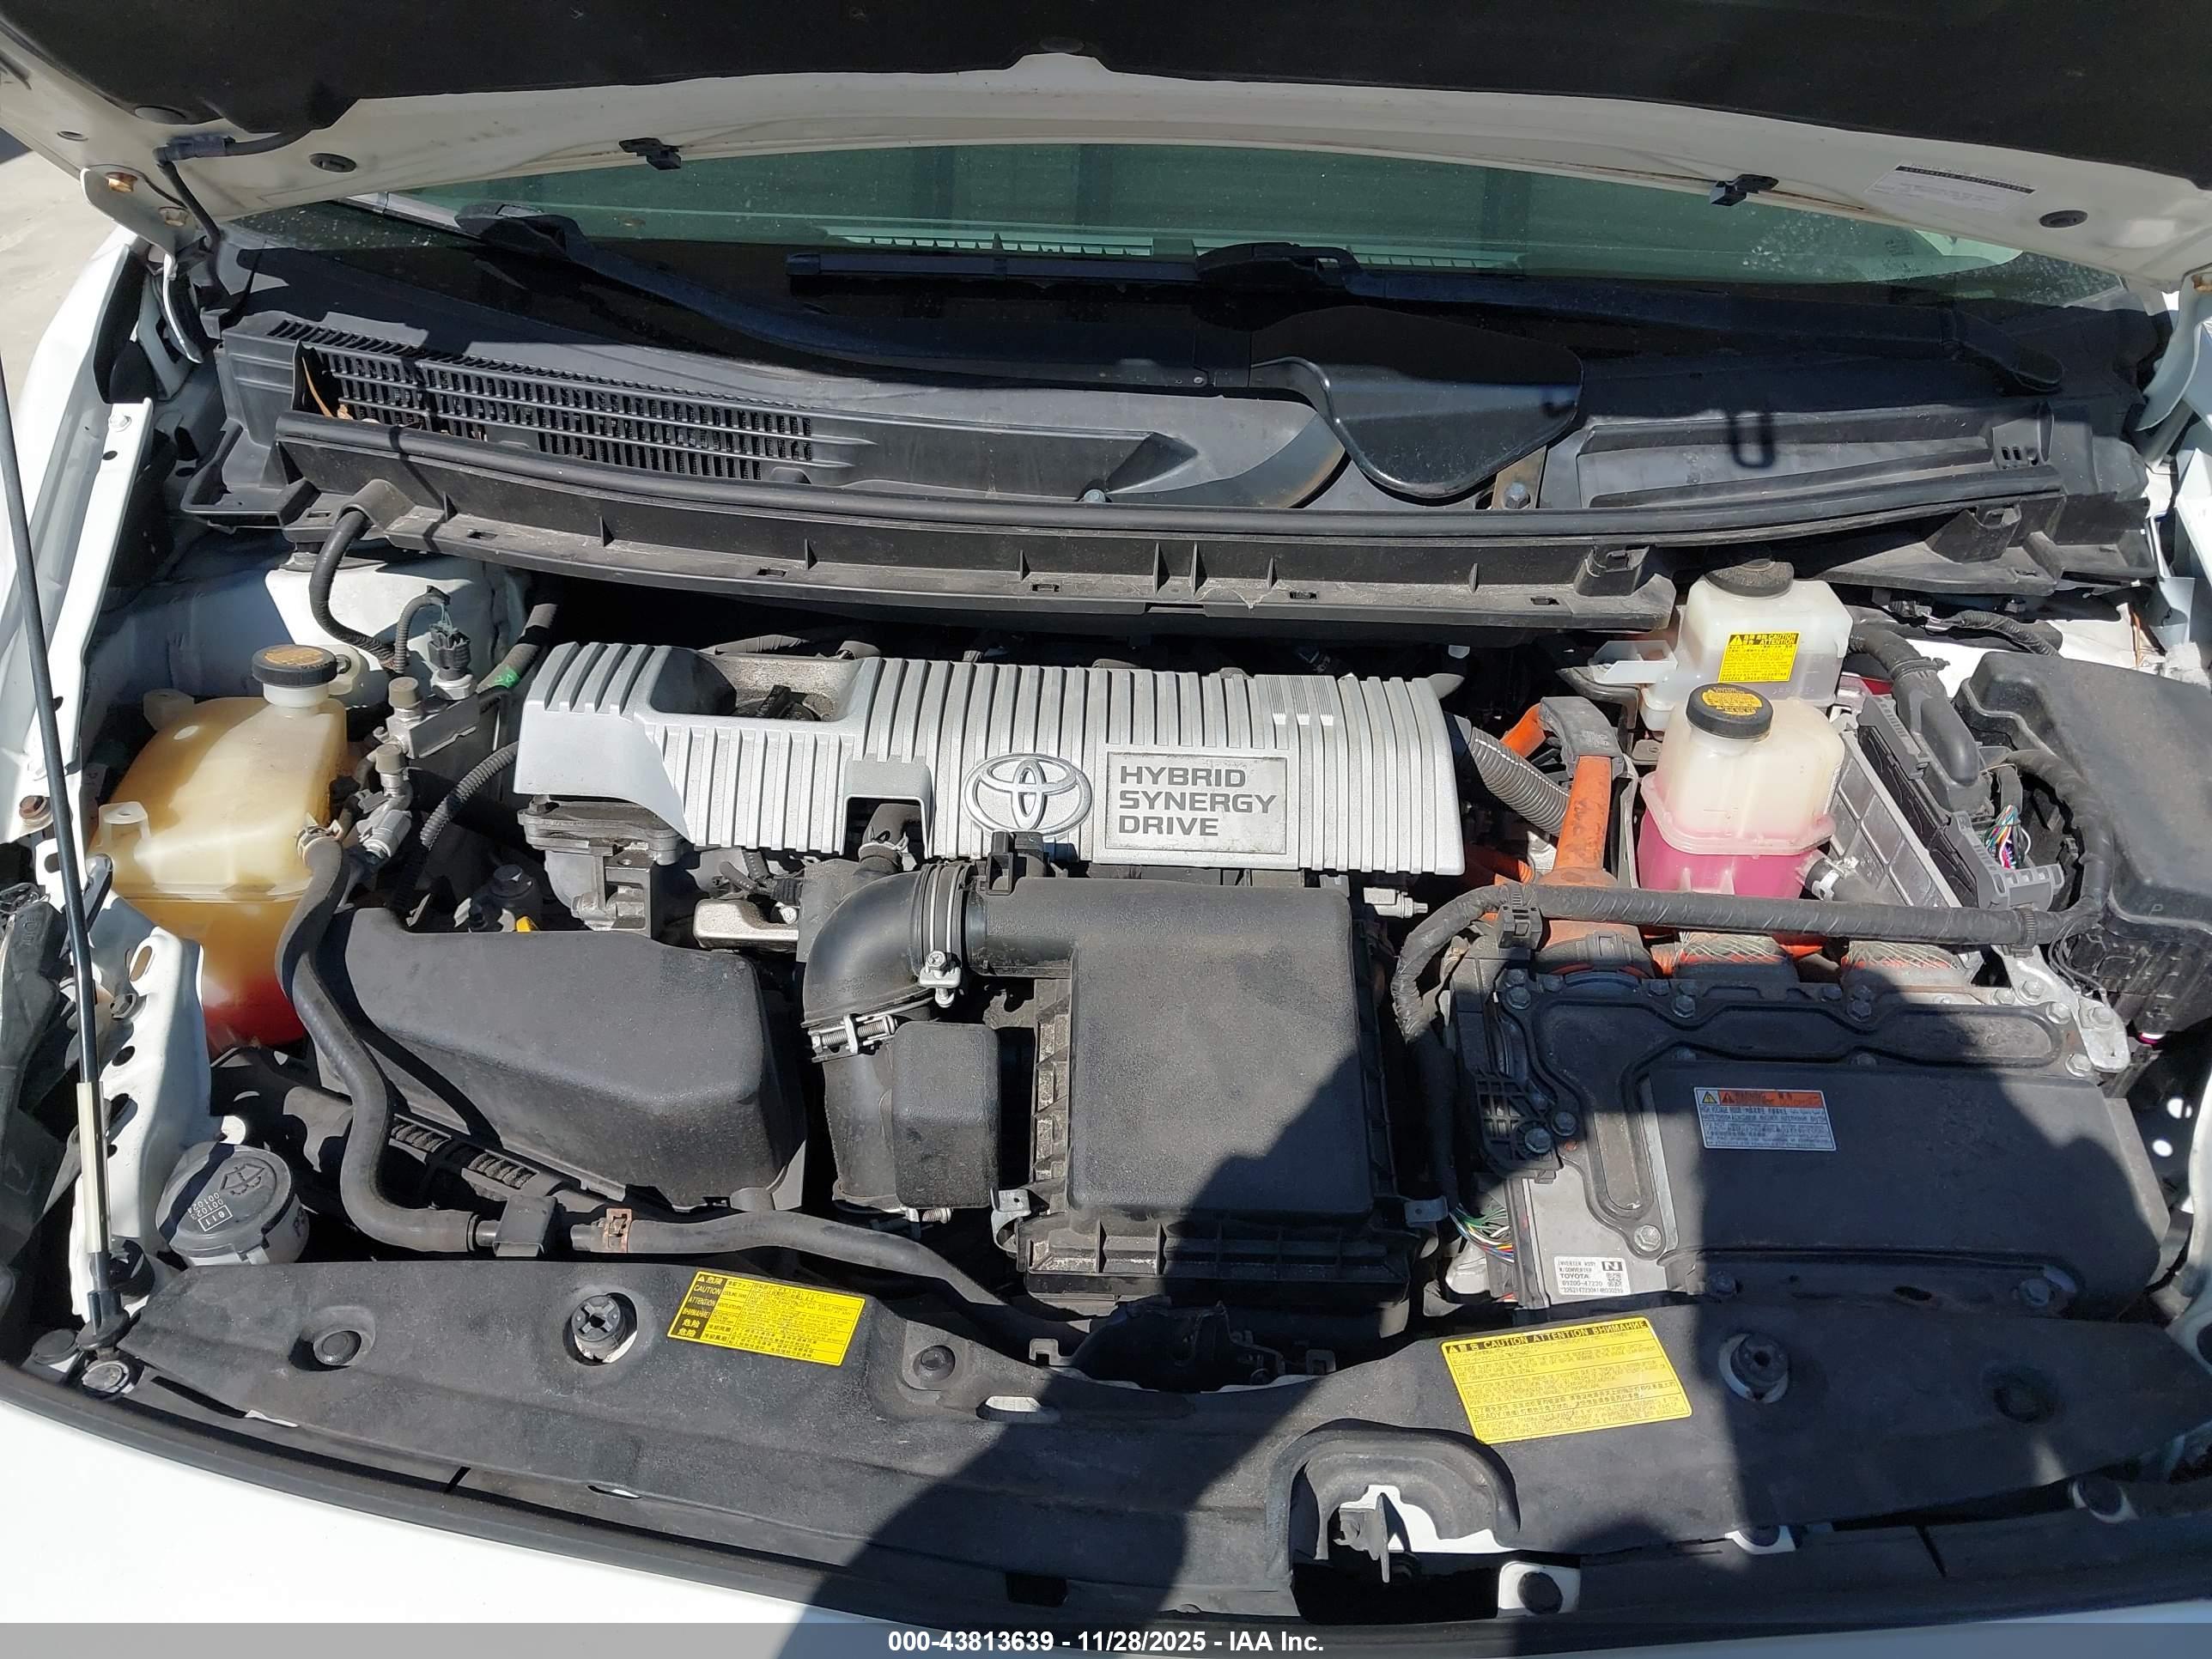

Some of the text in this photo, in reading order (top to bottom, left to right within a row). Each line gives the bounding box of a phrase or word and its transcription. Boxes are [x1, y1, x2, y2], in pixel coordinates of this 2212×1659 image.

[1120, 765, 1246, 787] HYBRID
[1119, 790, 1278, 814] SYNERGY
[1119, 815, 1219, 836] DRIVE
[190, 1199, 224, 1220] 001023
[693, 1285, 722, 1295] CAUTION
[688, 1297, 716, 1307] ATTENTION
[1483, 1336, 1528, 1349] CAUTION
[1533, 1328, 1589, 1343] ATTENTION
[1593, 1320, 1647, 1334] ВНИМАНИЕ
